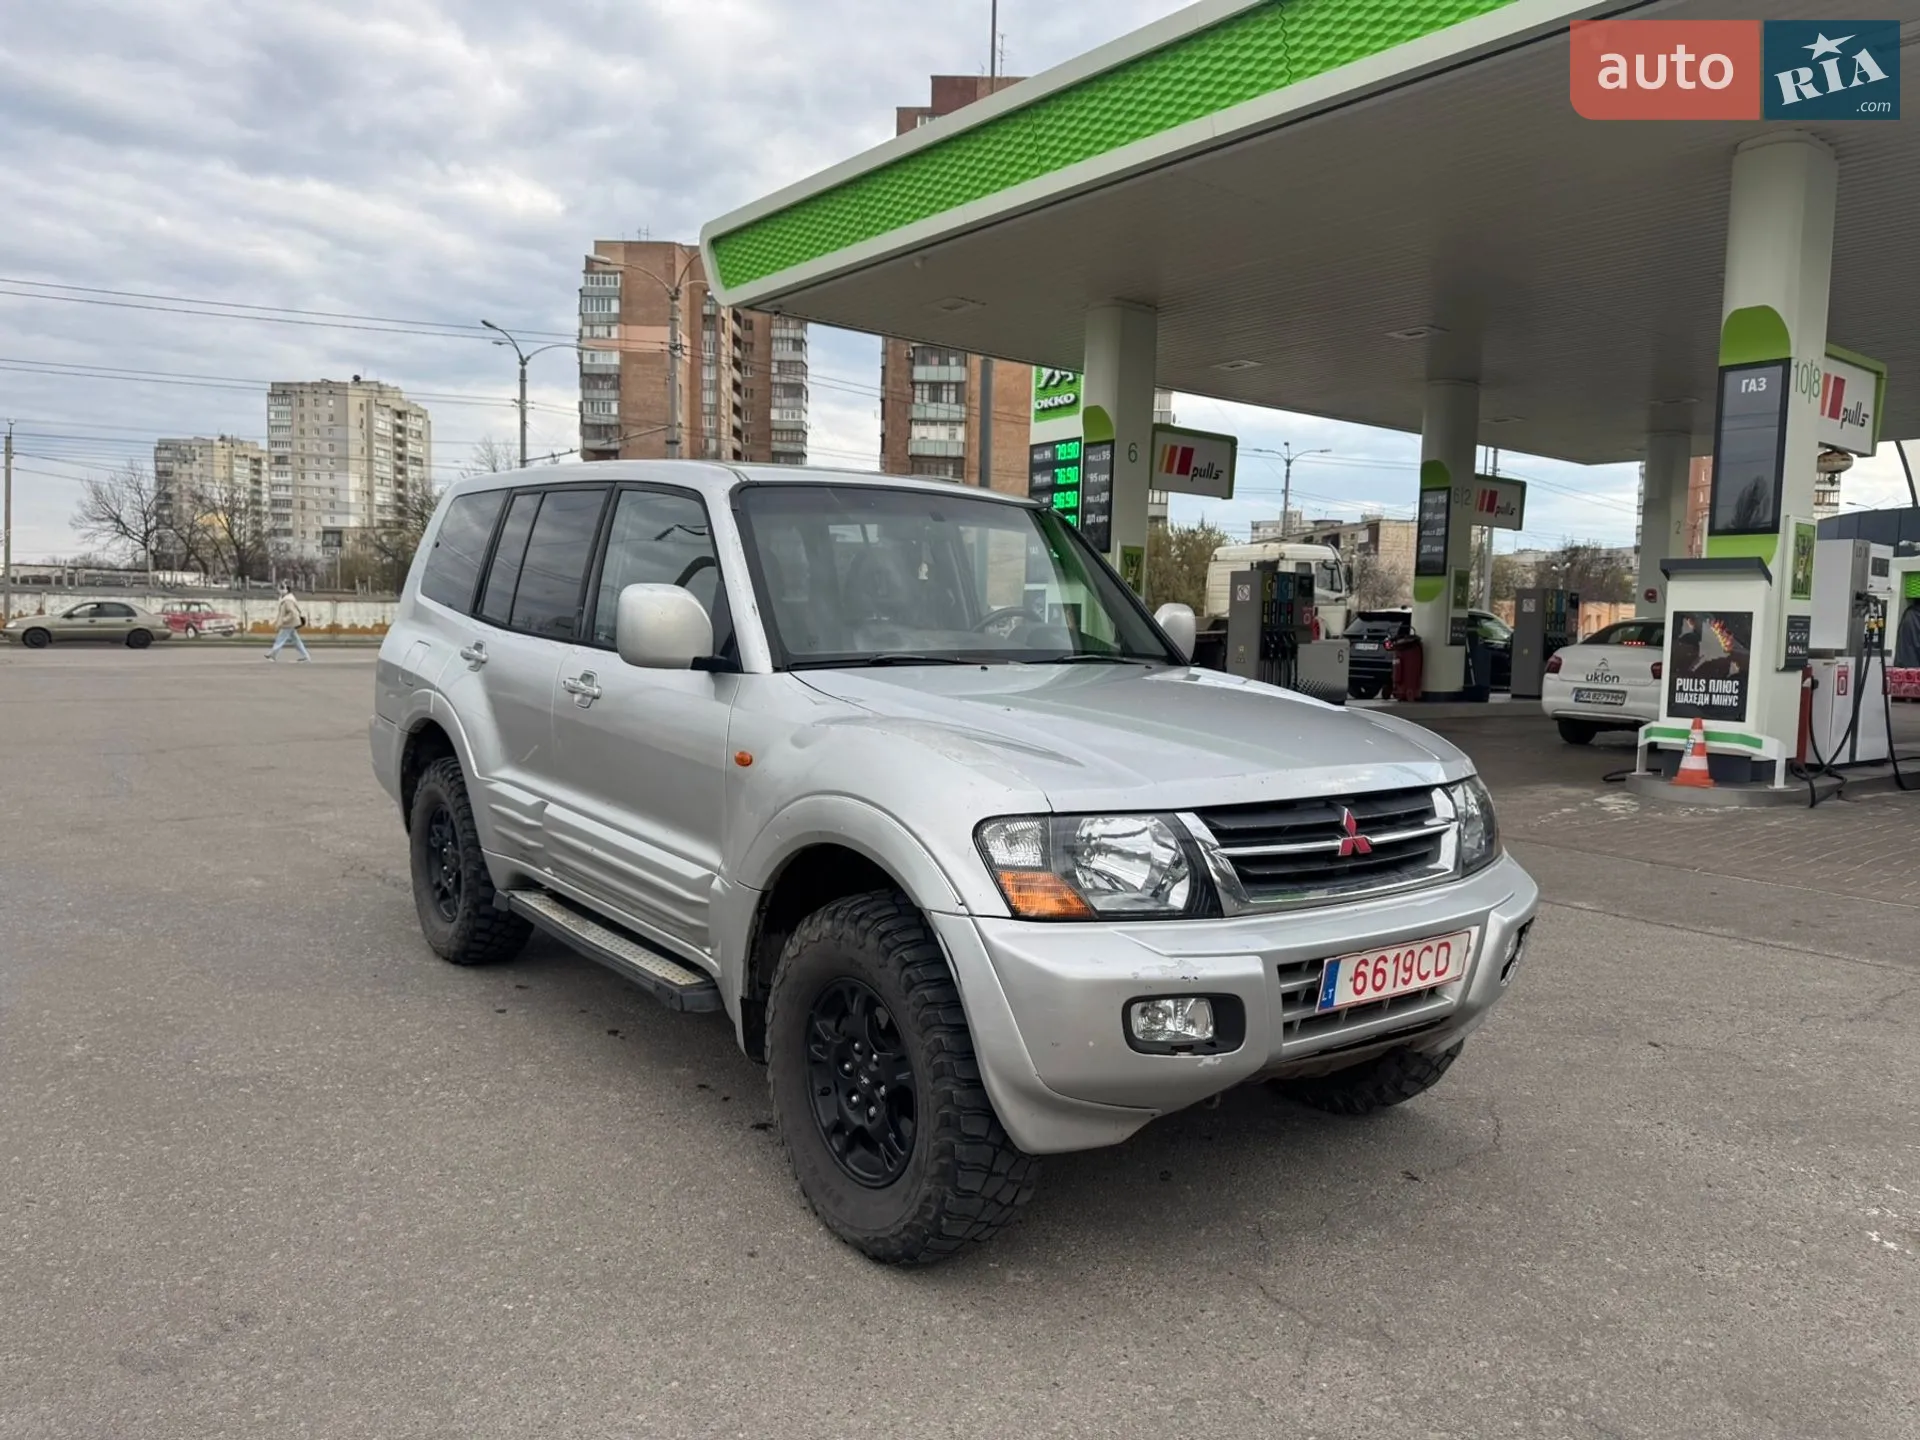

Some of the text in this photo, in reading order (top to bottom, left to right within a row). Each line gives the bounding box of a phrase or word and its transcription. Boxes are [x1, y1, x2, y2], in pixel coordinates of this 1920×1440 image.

[1740, 377, 1767, 393] ГАЗ
[1840, 401, 1869, 430] pulls
[1127, 442, 1138, 463] 6
[1190, 462, 1223, 482] pulls
[1337, 649, 1345, 664] 6
[1585, 671, 1620, 683] uklon
[1676, 678, 1739, 694] PULLS ПЛЮС
[1675, 692, 1738, 707] ШАХЕДИ МІНУС
[1353, 941, 1452, 996] 6619CD
